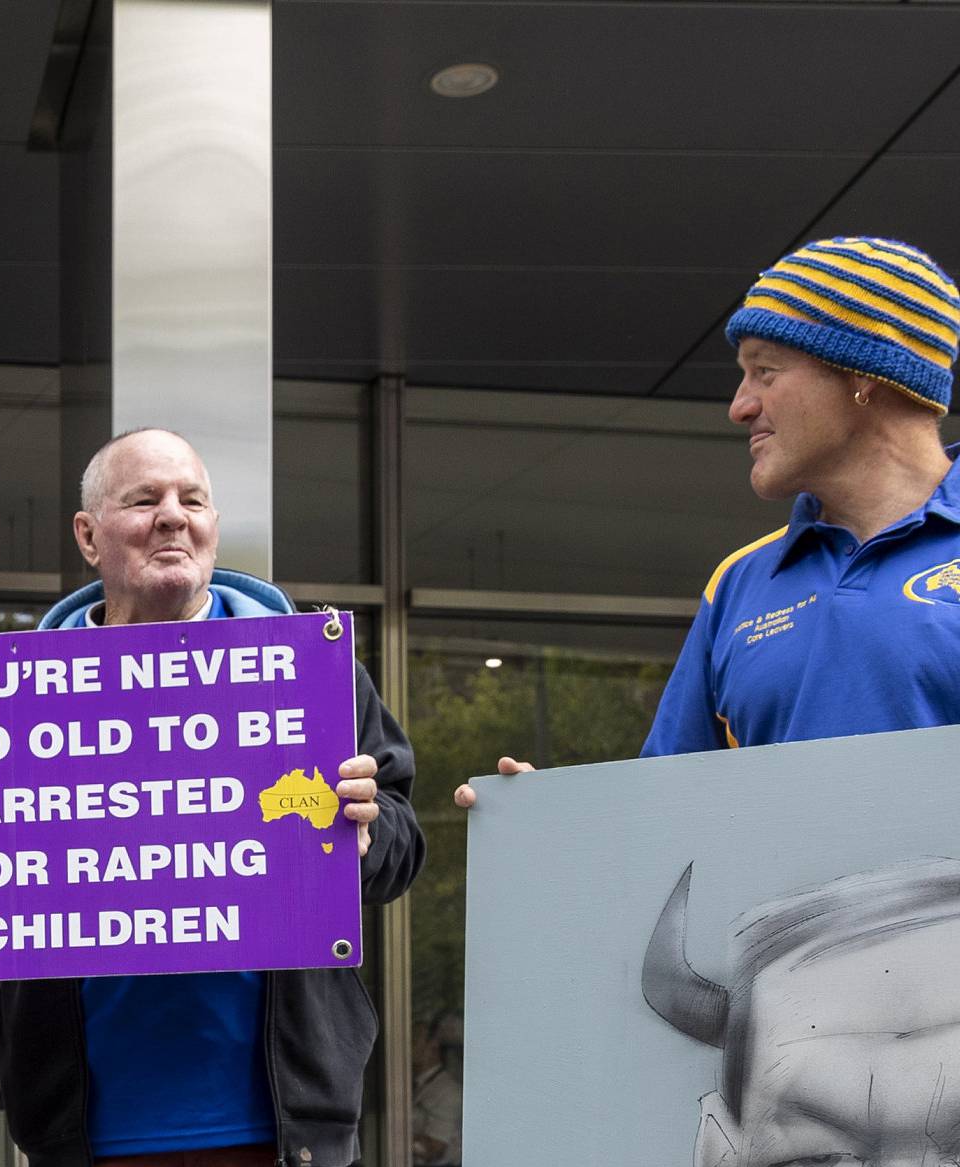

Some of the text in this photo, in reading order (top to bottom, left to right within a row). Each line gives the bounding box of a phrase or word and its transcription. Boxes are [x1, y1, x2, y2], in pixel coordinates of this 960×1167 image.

[120, 644, 296, 690] NEVER
[29, 719, 133, 758] OLD
[148, 714, 220, 752] TO
[238, 708, 306, 747] BE
[279, 794, 321, 810] CLAN
[66, 839, 267, 884] RAPING
